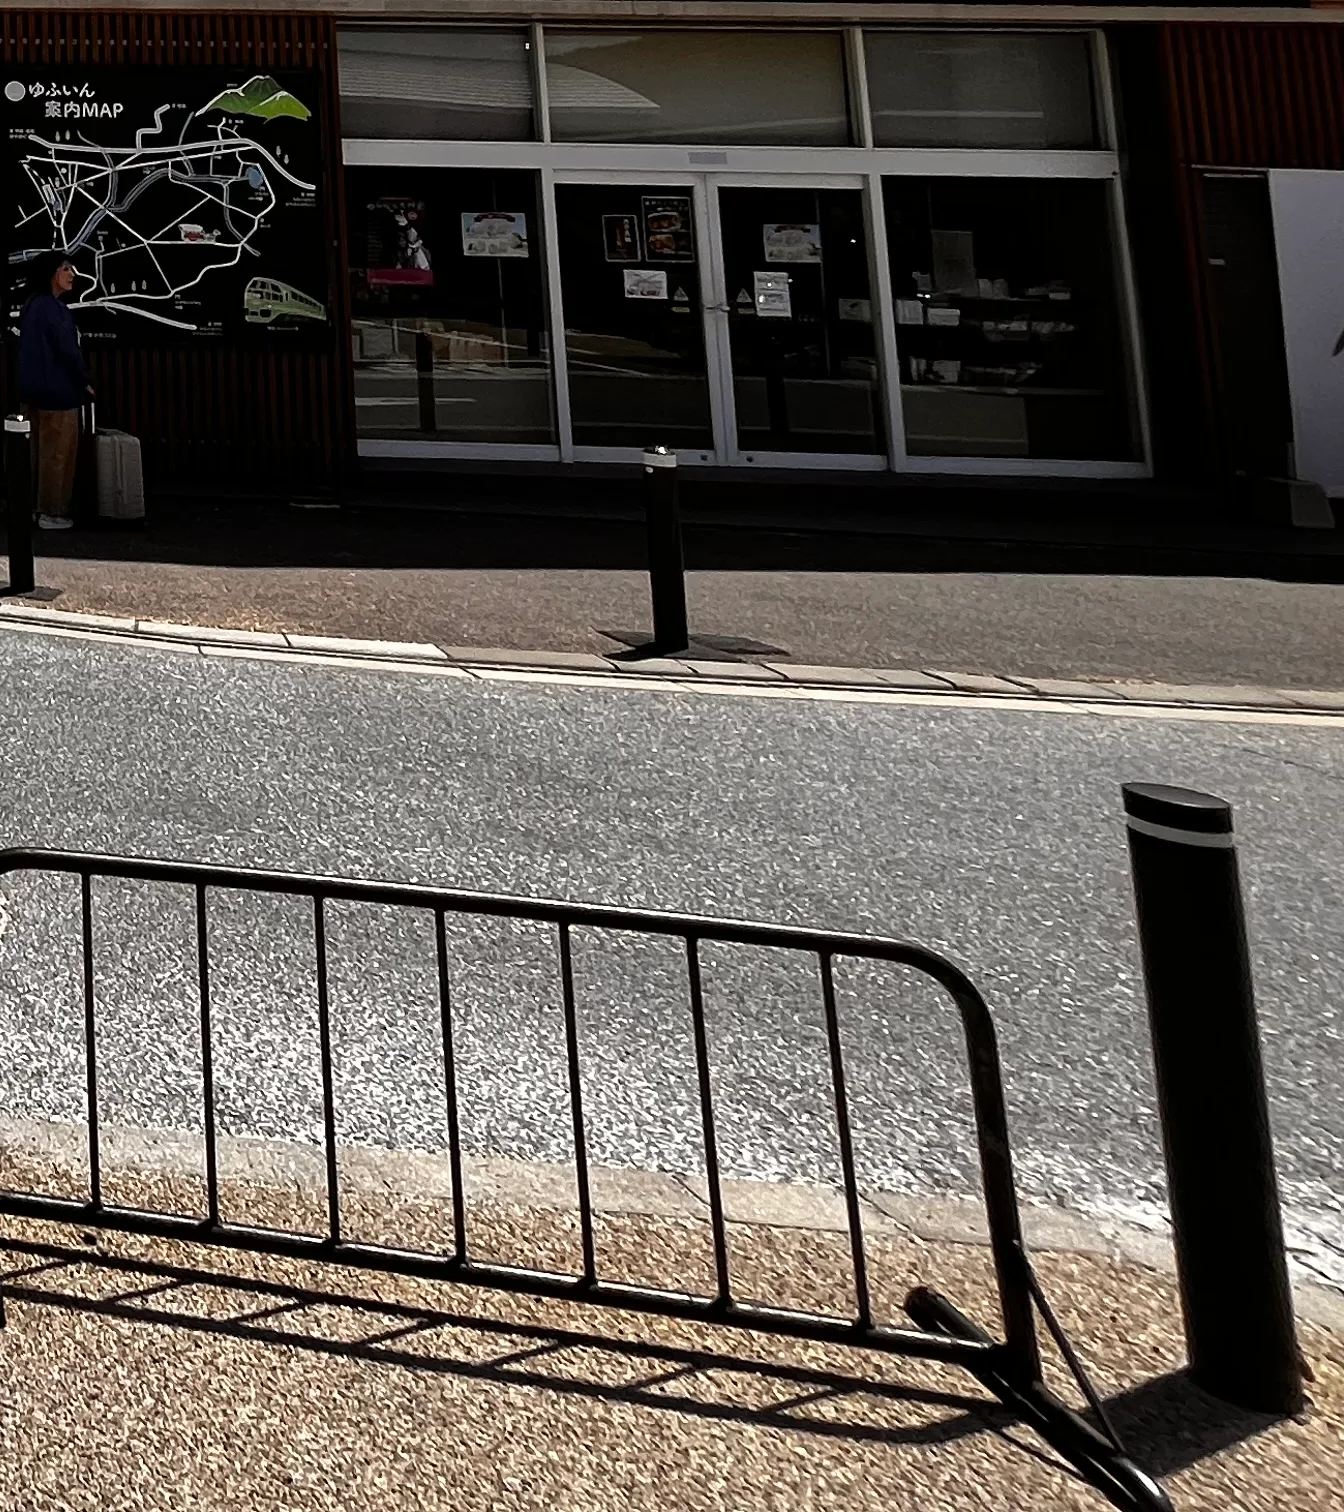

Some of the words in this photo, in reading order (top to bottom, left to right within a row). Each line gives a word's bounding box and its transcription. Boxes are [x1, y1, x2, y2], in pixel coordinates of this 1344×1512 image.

[28, 81, 96, 98] ゆふいん
[44, 99, 124, 120] 案内MAP
